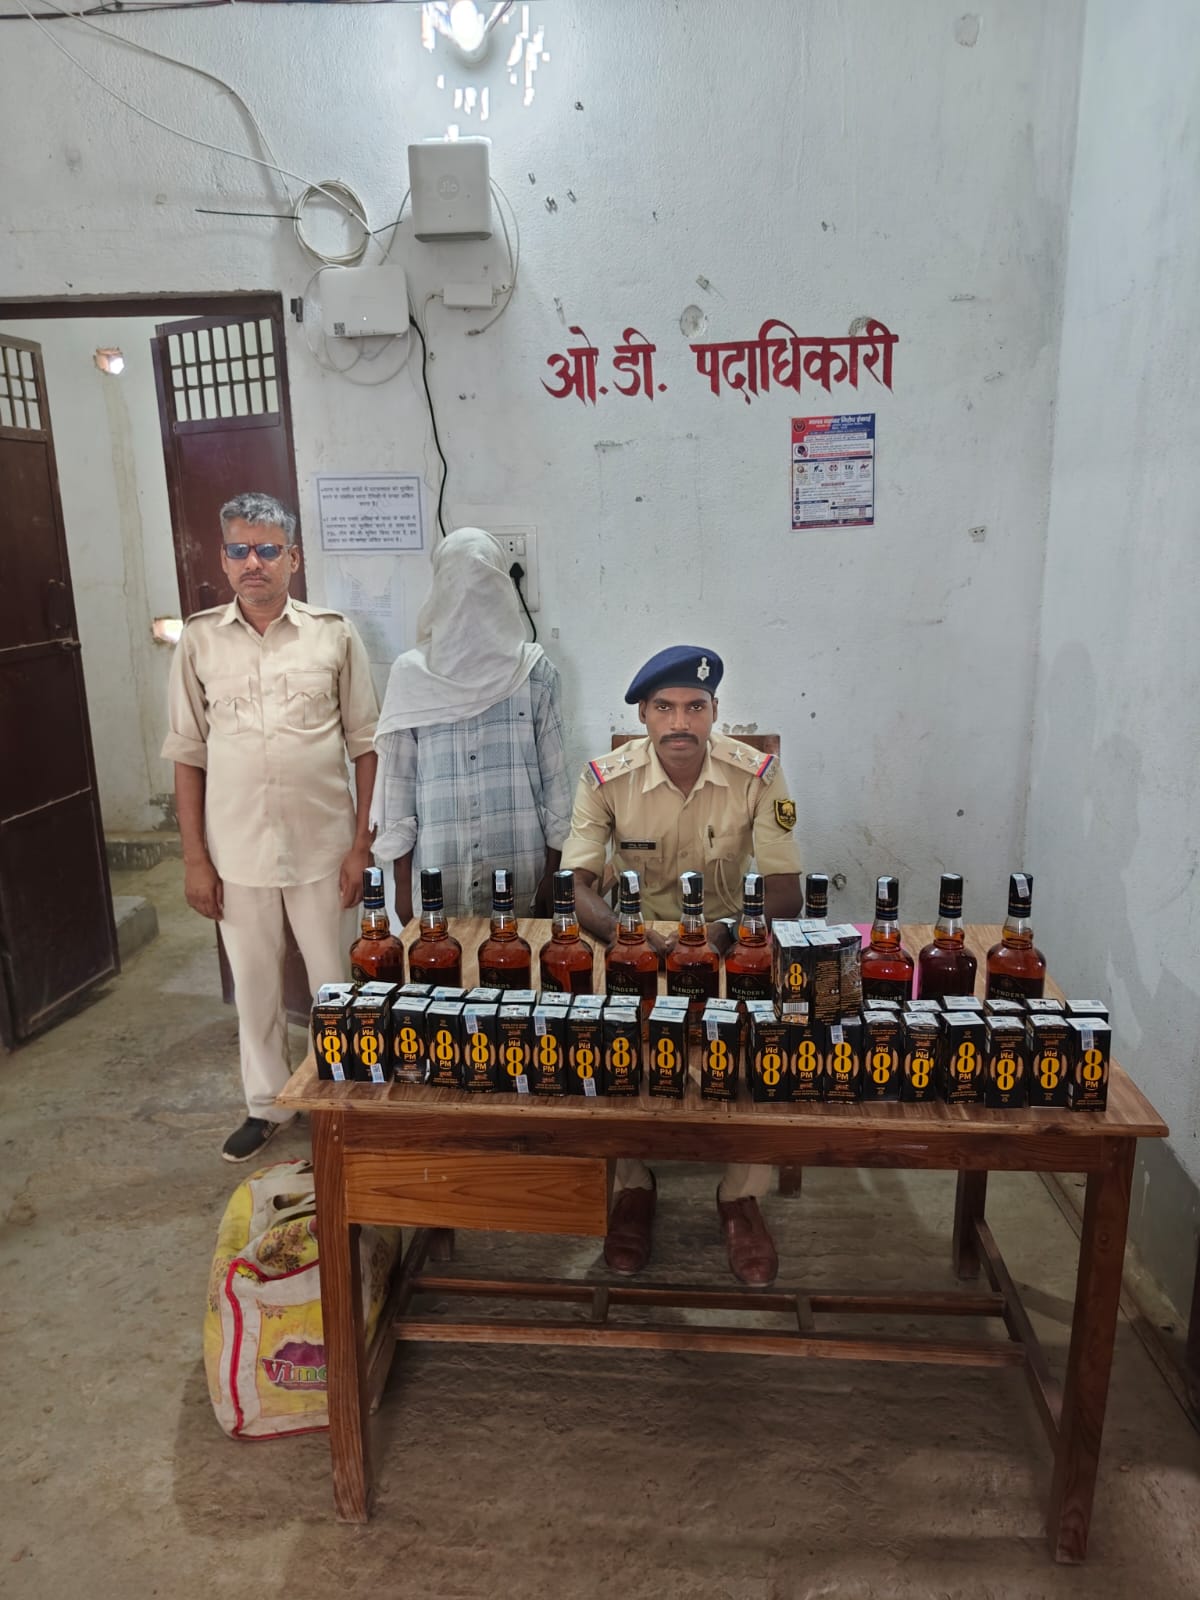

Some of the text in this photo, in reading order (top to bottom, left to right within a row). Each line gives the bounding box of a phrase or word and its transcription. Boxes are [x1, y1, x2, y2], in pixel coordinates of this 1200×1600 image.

[690, 319, 899, 405] पदाधिकारी
[790, 963, 803, 985] 8
[325, 1028, 337, 1036] PM
[362, 1028, 375, 1036] PM
[400, 1027, 418, 1054] 8
[436, 1030, 453, 1060] 8
[323, 1036, 341, 1064] 8
[360, 1036, 377, 1065] 8
[472, 1033, 489, 1063] 8
[506, 1046, 523, 1076] 8
[540, 1034, 557, 1066] 8
[612, 1037, 630, 1068] 8
[657, 1038, 675, 1069] 8
[709, 1040, 727, 1071] 8
[798, 1041, 816, 1072] 8
[834, 1042, 852, 1073] 8
[875, 1046, 889, 1054] PM
[915, 1050, 929, 1058] PM
[957, 1041, 975, 1073] 8
[1043, 1050, 1057, 1058] PM
[474, 1063, 487, 1071] PM
[542, 1065, 555, 1073] PM
[576, 1049, 593, 1079] 8
[615, 1067, 628, 1075] PM
[659, 1068, 672, 1076] PM
[712, 1070, 724, 1078] PM
[762, 1054, 780, 1085] 8
[836, 1072, 849, 1080] PM
[872, 1053, 891, 1084] 8
[911, 1058, 930, 1088] 8
[958, 1072, 971, 1080] PM
[997, 1059, 1015, 1090] 8
[1040, 1057, 1060, 1089] 8
[1083, 1049, 1103, 1081] 8
[1085, 1080, 1099, 1088] PM
